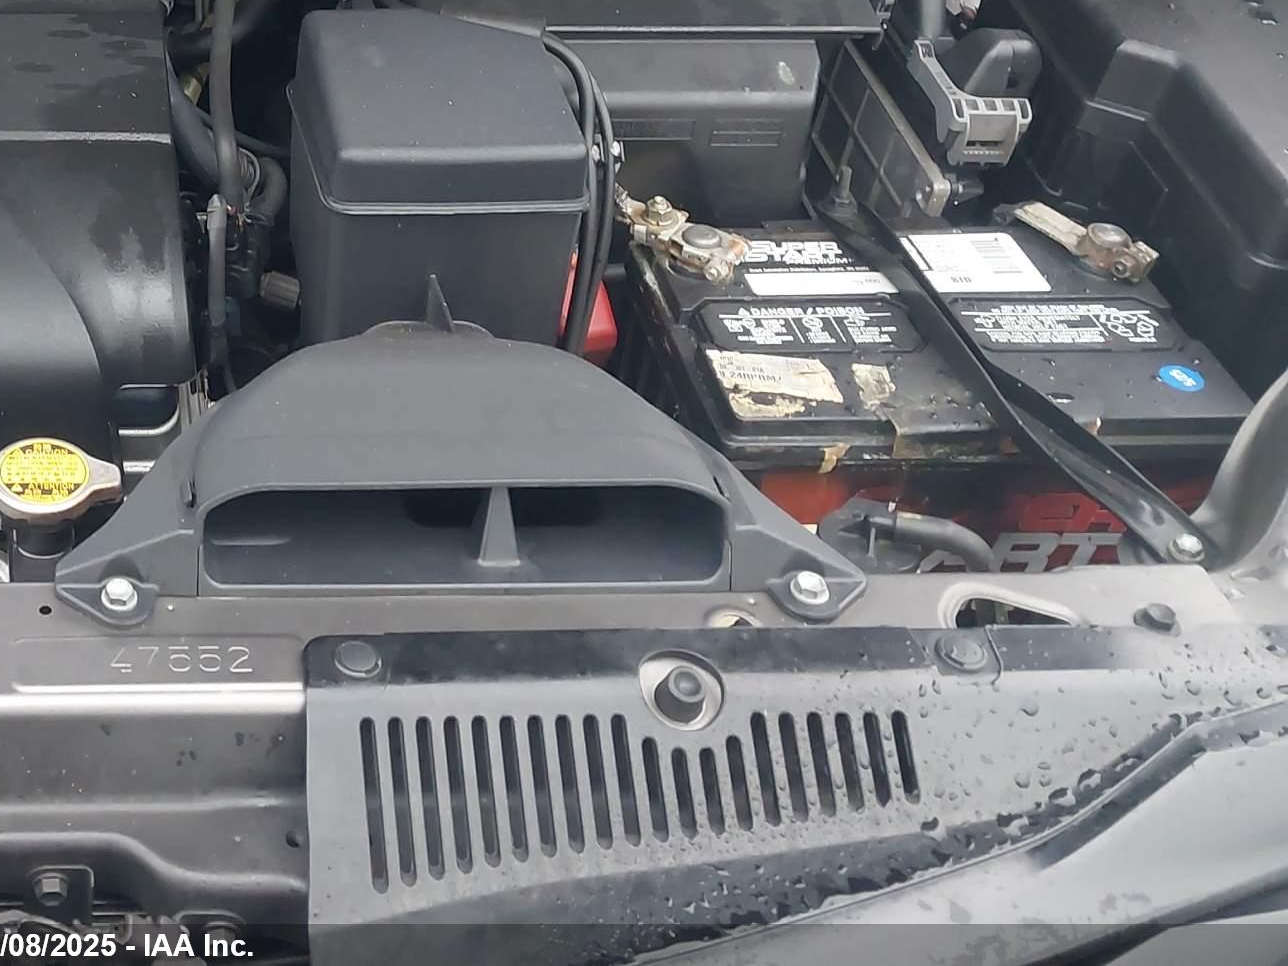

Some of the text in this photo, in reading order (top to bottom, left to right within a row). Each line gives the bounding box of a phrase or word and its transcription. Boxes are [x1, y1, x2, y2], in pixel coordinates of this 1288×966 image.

[750, 307, 804, 316] DANGER
[815, 307, 866, 316] POISON
[110, 645, 254, 673] 47552
